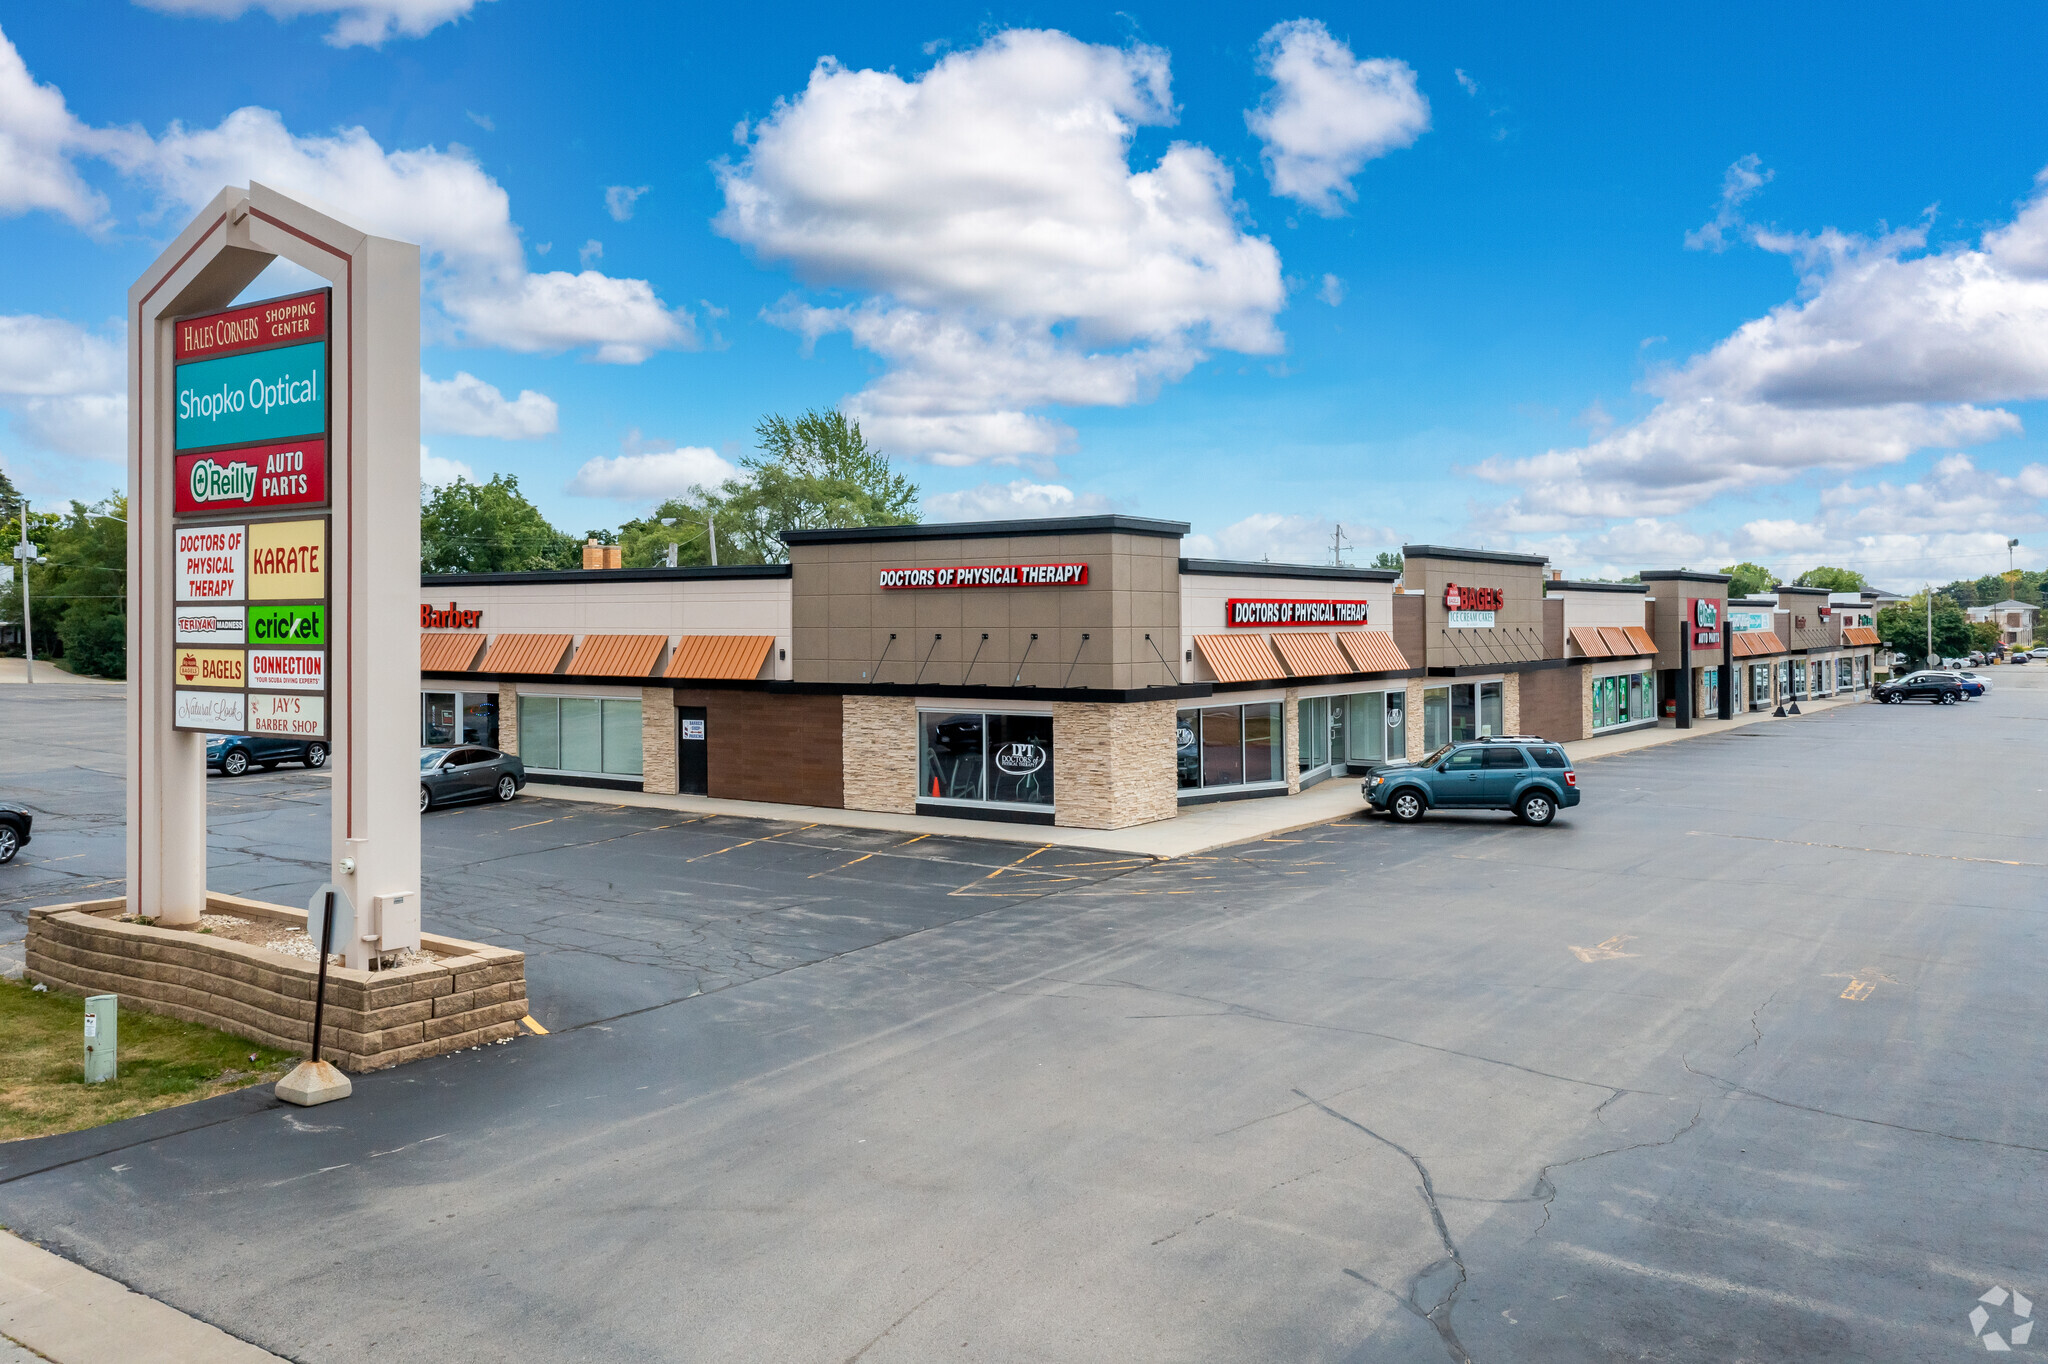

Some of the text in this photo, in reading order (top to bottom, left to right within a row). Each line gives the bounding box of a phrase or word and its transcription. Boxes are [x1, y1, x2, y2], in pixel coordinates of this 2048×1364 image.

[266, 302, 316, 323] SHOPPING
[184, 316, 258, 351] HALES CORNERS
[272, 321, 310, 337] CENTER
[180, 370, 316, 421] Shopko Optical
[266, 451, 303, 474] AUTO
[192, 460, 255, 498] O'Reilly
[262, 474, 307, 497] PARTS
[180, 533, 242, 552] DOCTORS OF
[187, 556, 234, 574] PHYSICAL
[253, 546, 319, 574] KARATE
[880, 565, 1082, 586] DOCTORS OF PHYSICAL THERAPY
[189, 580, 234, 597] THERAPY
[1461, 587, 1504, 610] BAGELS
[421, 602, 482, 628] Barber
[1236, 603, 1370, 623] DOCTORS OF PHYSICAL THERAPY
[1450, 612, 1493, 622] ICE CREAM CAKES
[179, 617, 243, 632] TERIYAKI MADNESS
[255, 612, 319, 639] cricket
[202, 660, 241, 679] BAGELS
[254, 656, 321, 675] CONNECTION
[179, 697, 242, 721] Natural Look
[272, 698, 300, 714] JAY'S
[256, 718, 318, 733] BARBER SHOP
[1012, 744, 1034, 756] DPT
